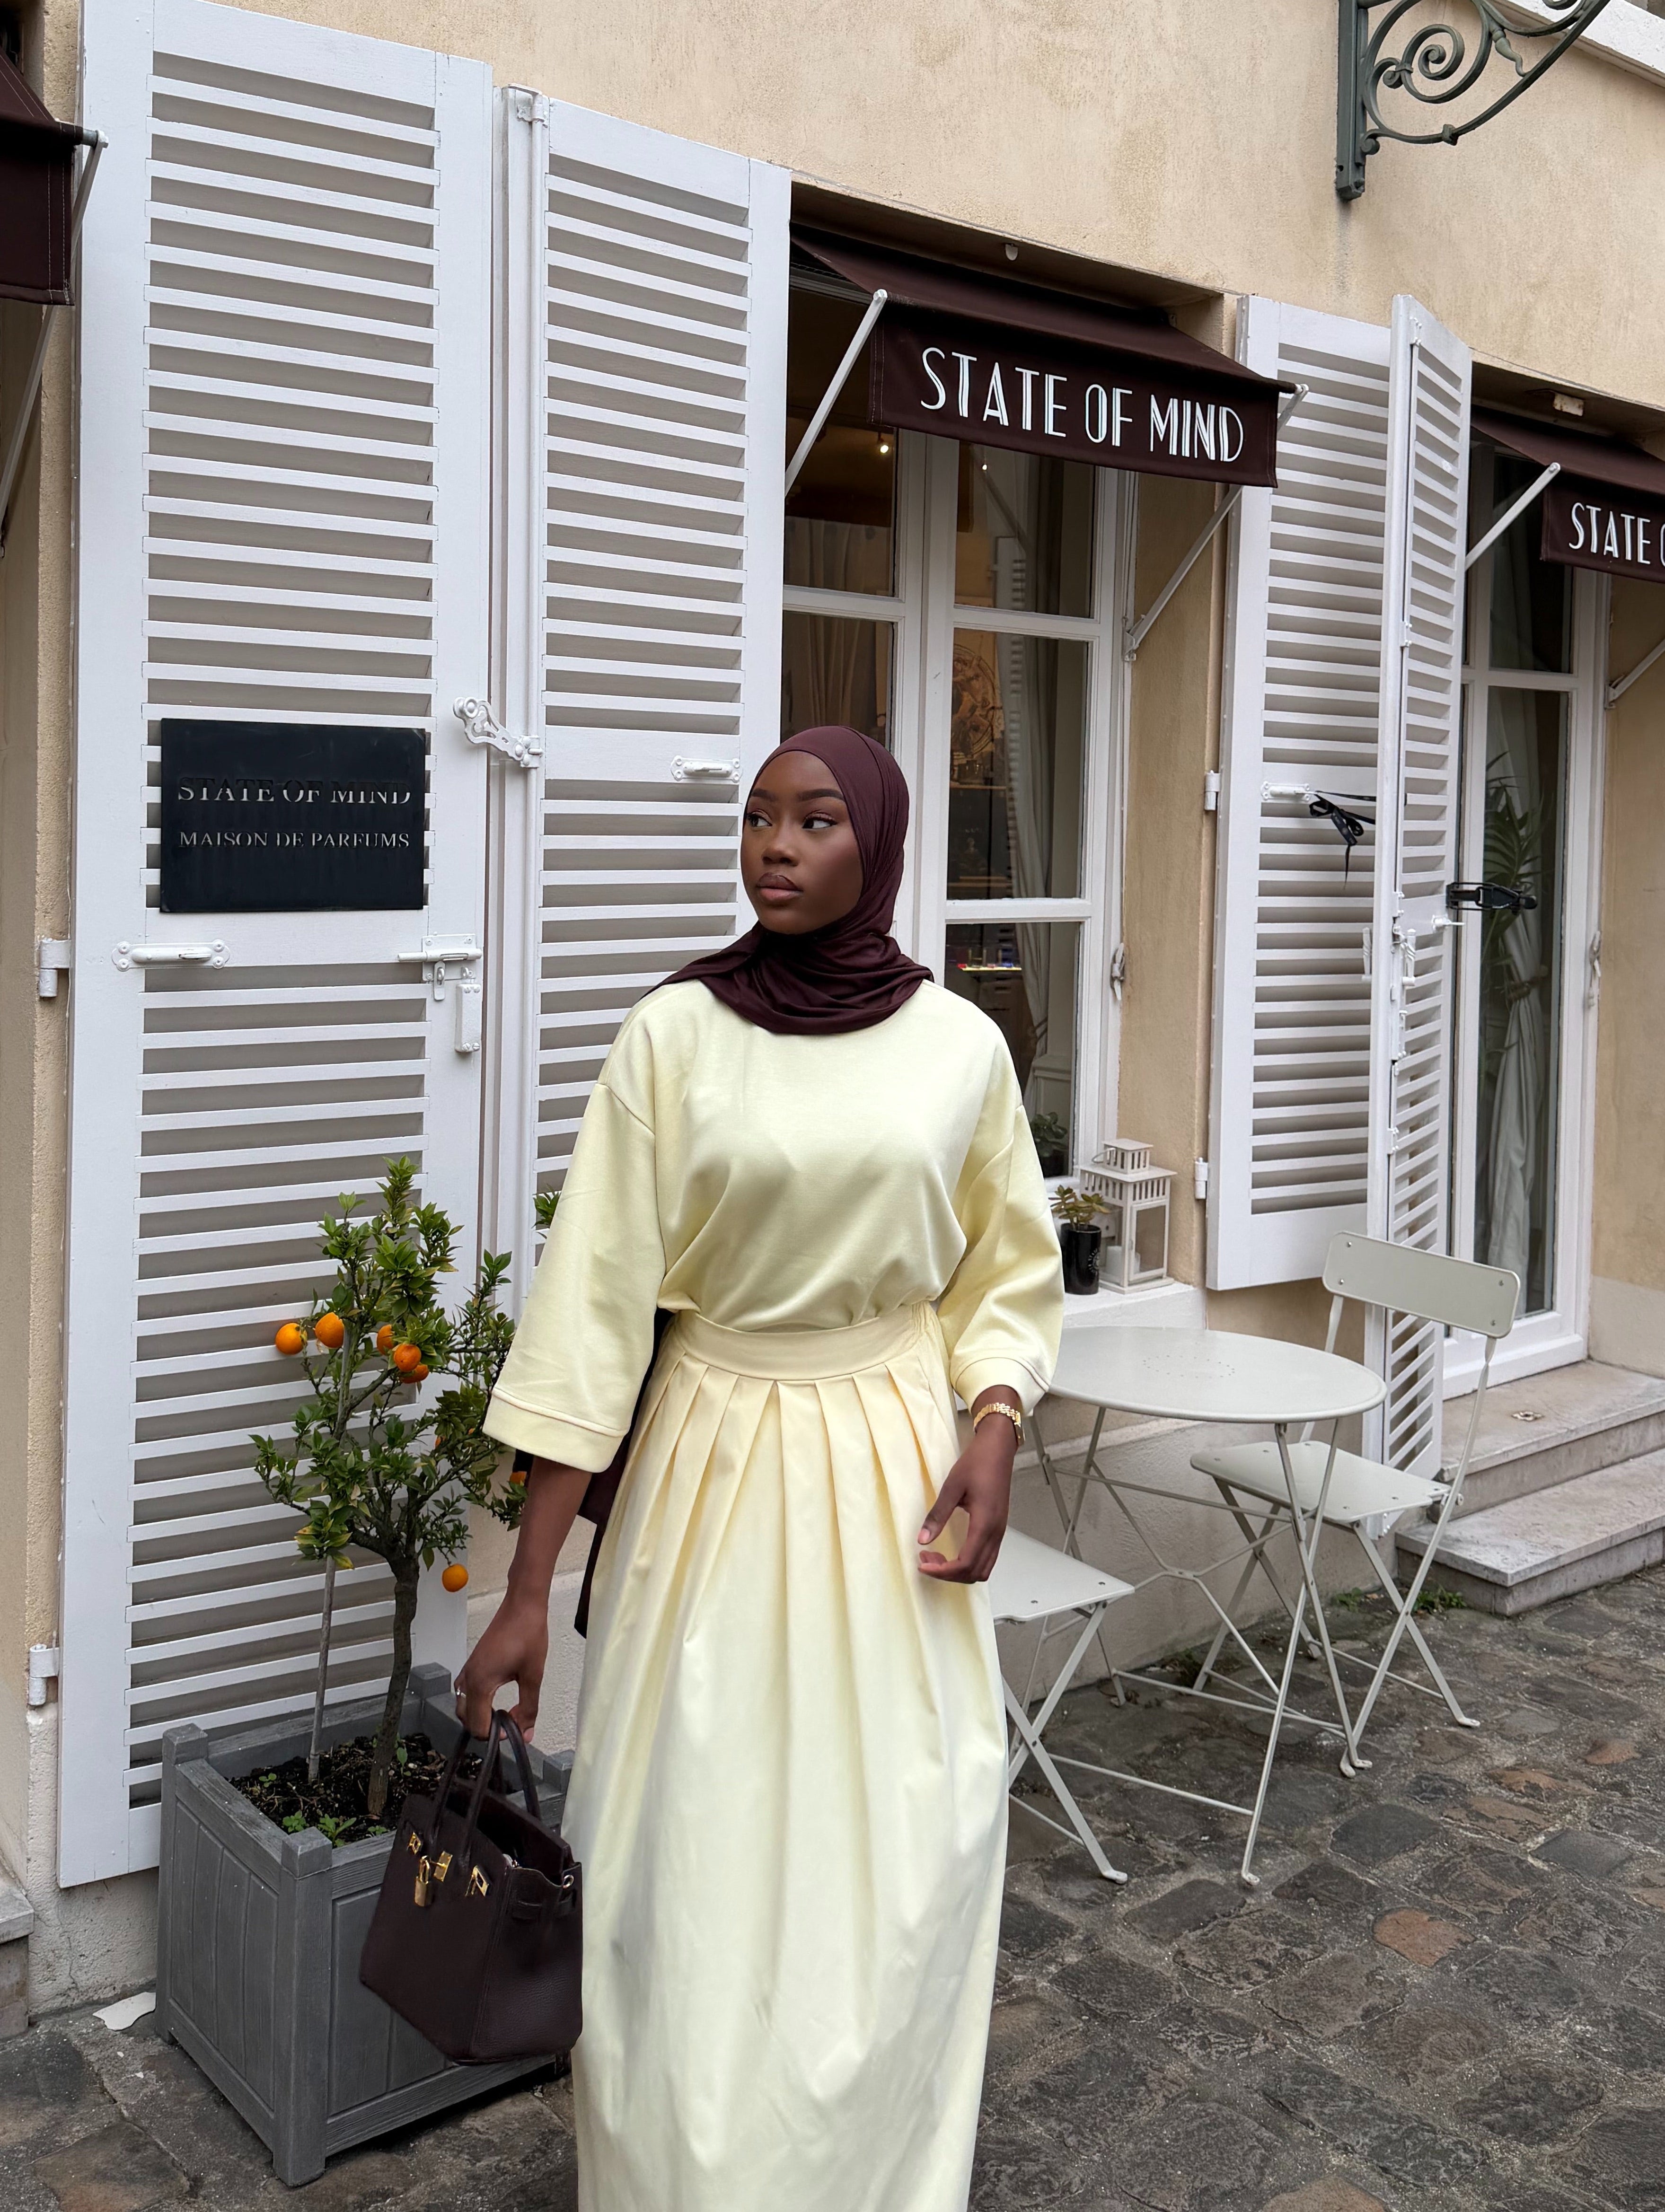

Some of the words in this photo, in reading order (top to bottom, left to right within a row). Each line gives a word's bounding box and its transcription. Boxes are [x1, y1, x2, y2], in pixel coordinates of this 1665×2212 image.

[921, 347, 1067, 437] STATE
[1085, 384, 1133, 447] OF
[1150, 394, 1243, 462] MIND
[1568, 502, 1651, 564] STATE
[177, 777, 274, 802] STATE
[282, 778, 323, 803] OF
[330, 781, 411, 804] MIND
[179, 831, 268, 848] MAISON
[276, 831, 304, 848] DE
[311, 832, 410, 849] PARFUMS
